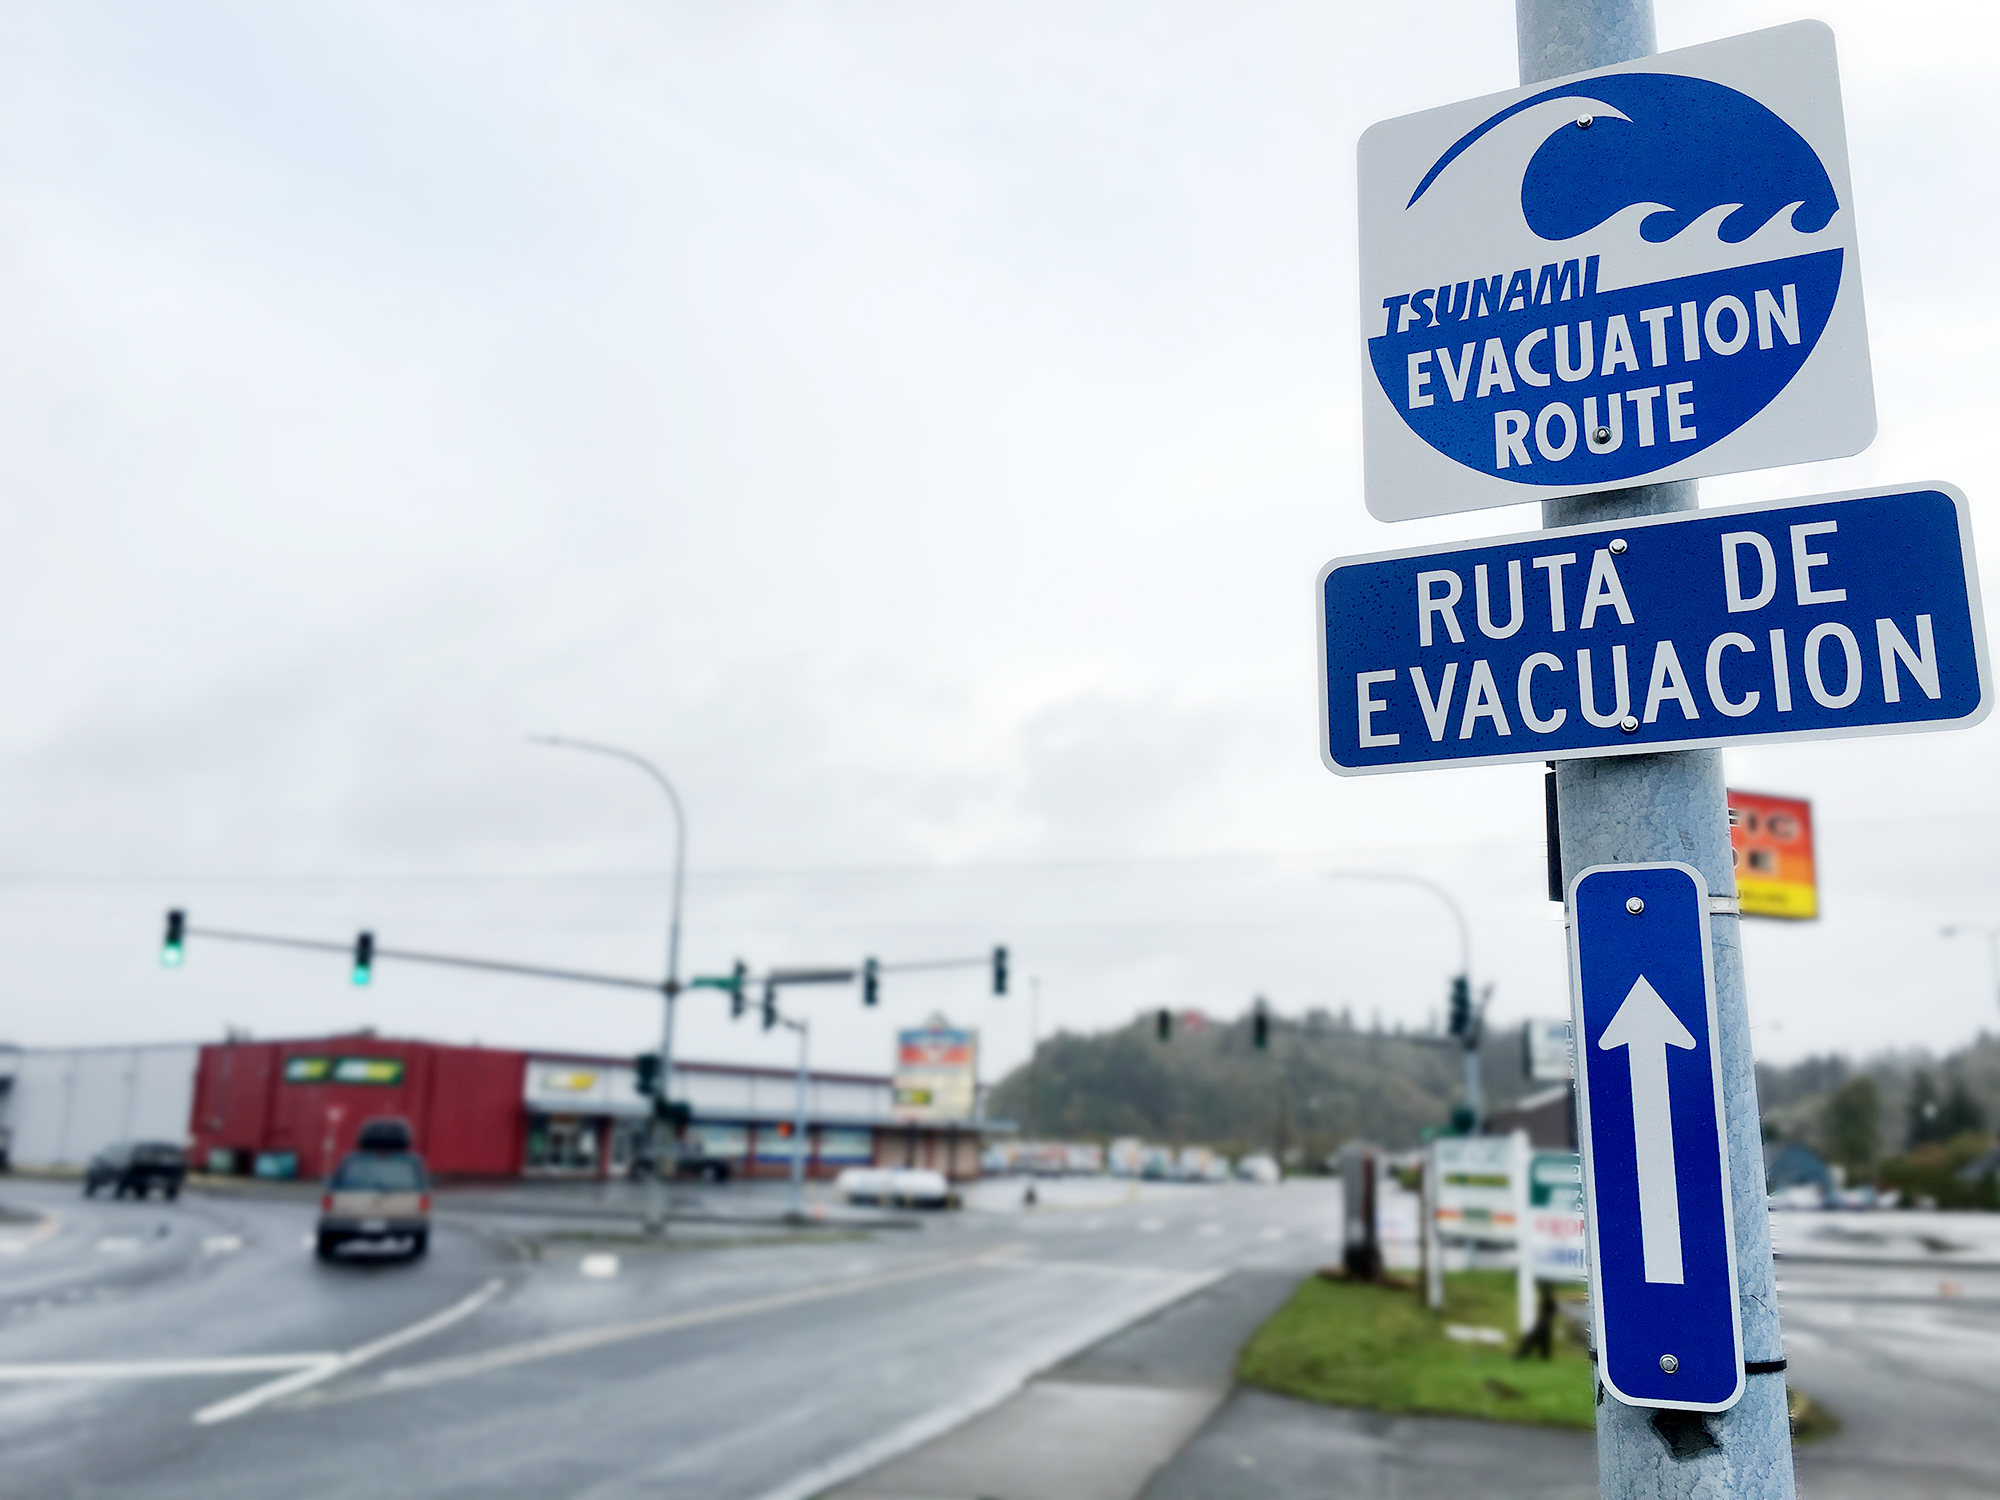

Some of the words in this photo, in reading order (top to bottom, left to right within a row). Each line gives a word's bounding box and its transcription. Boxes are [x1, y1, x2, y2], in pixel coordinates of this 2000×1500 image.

[1382, 254, 1601, 337] TSUNAMI
[1406, 283, 1801, 410] EVACUATION
[1494, 381, 1697, 469] ROUTE
[1416, 548, 1635, 647] RUTA
[1720, 520, 1848, 613] DE
[1356, 614, 1942, 749] EVACUACION
